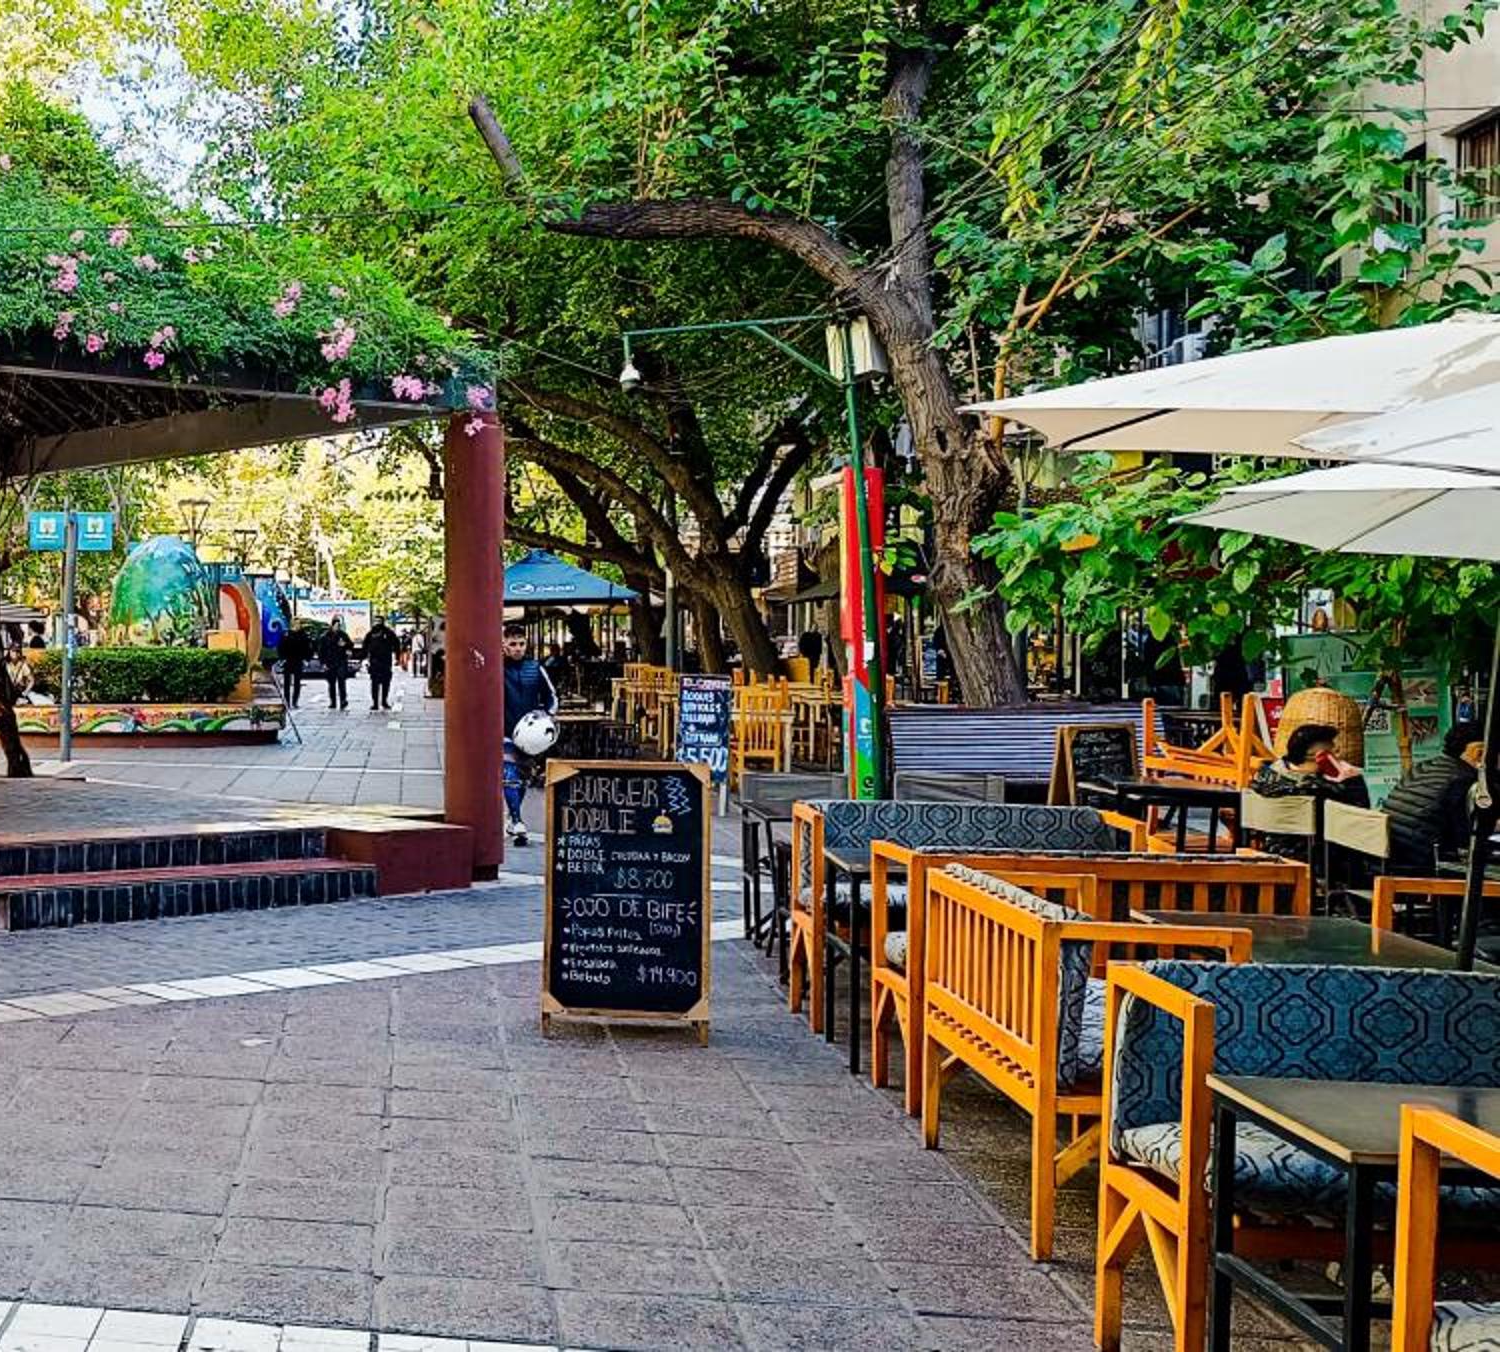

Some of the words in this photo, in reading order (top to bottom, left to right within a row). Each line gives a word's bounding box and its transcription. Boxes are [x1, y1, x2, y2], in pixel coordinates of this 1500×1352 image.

[568, 776, 659, 807] BURGER
[562, 806, 637, 834] DOBLE
[567, 848, 605, 861] DOBLE
[573, 897, 610, 917] OJO
[620, 899, 643, 917] DE
[647, 900, 685, 923] BIFE
